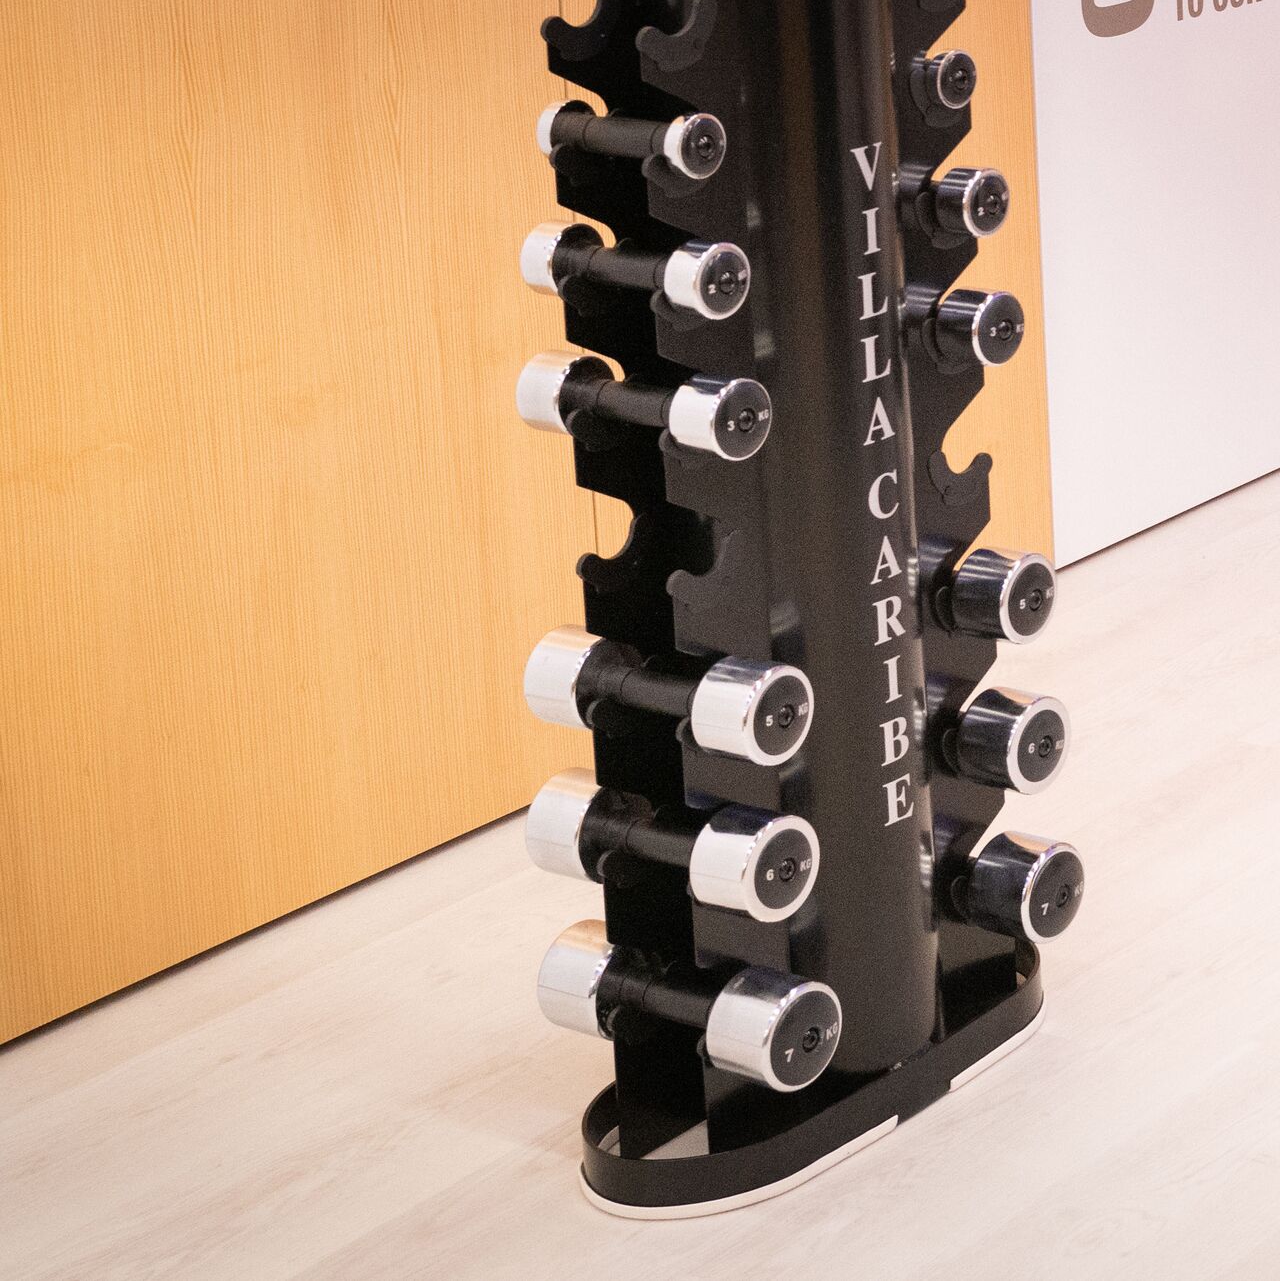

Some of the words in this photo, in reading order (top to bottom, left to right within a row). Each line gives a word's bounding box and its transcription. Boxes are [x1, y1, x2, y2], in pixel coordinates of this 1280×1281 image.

[708, 283, 717, 295] 2
[850, 141, 896, 447] VILLA
[990, 326, 998, 337] 3
[727, 420, 736, 432] 3
[1019, 599, 1027, 610] 5
[867, 468, 915, 827] CARIBE
[765, 714, 774, 727] 5
[1028, 742, 1036, 754] 6
[766, 868, 775, 881] 6
[800, 859, 812, 872] KG
[1041, 902, 1050, 916] 7
[785, 1048, 795, 1063] 7
[826, 1021, 838, 1041] KG
